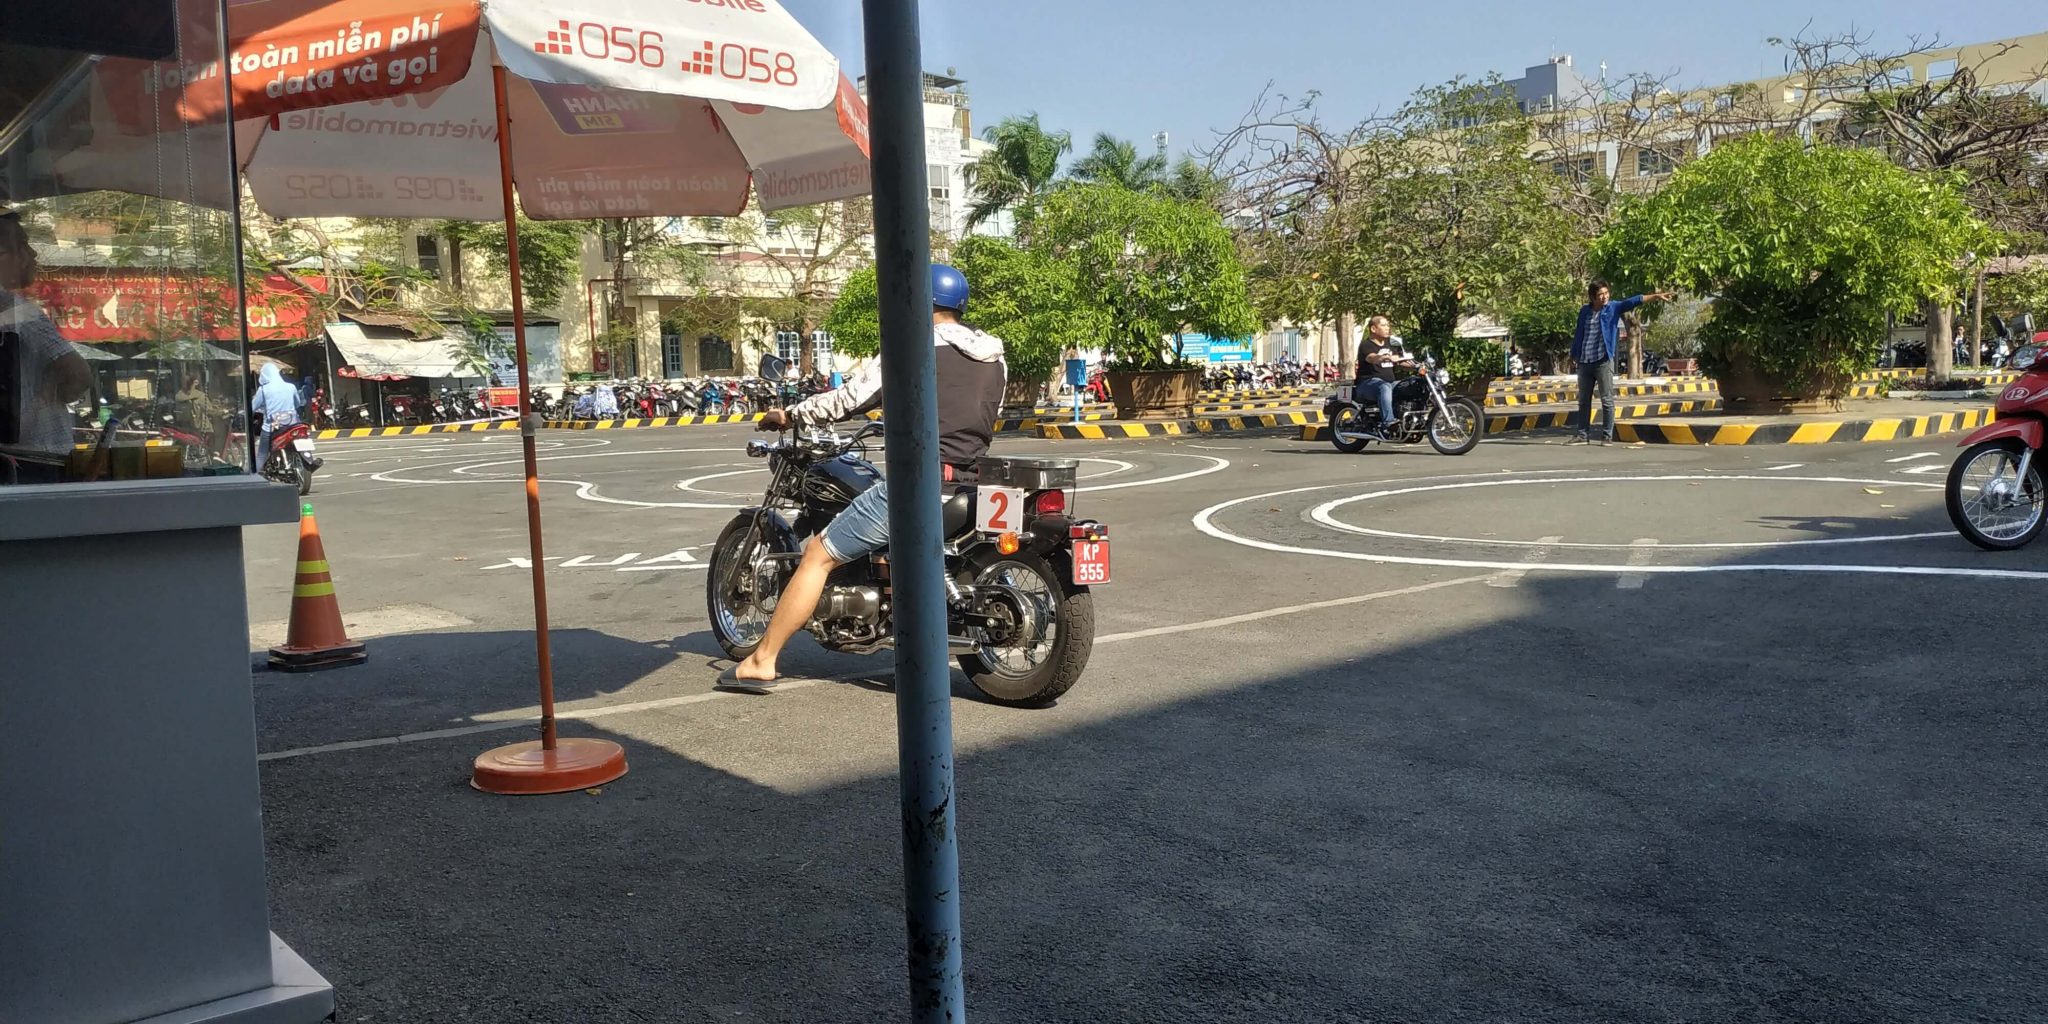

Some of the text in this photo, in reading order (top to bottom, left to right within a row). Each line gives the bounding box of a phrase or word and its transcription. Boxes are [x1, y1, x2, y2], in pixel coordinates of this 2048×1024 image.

[230, 44, 298, 75] toàn
[308, 20, 382, 61] miễn
[389, 13, 443, 52] phí
[577, 22, 798, 87] 056 058
[266, 47, 438, 98] data và gọi
[2009, 389, 2026, 400] 12
[988, 491, 1009, 530] 2
[1083, 543, 1100, 561] KP
[1079, 563, 1105, 581] 355
